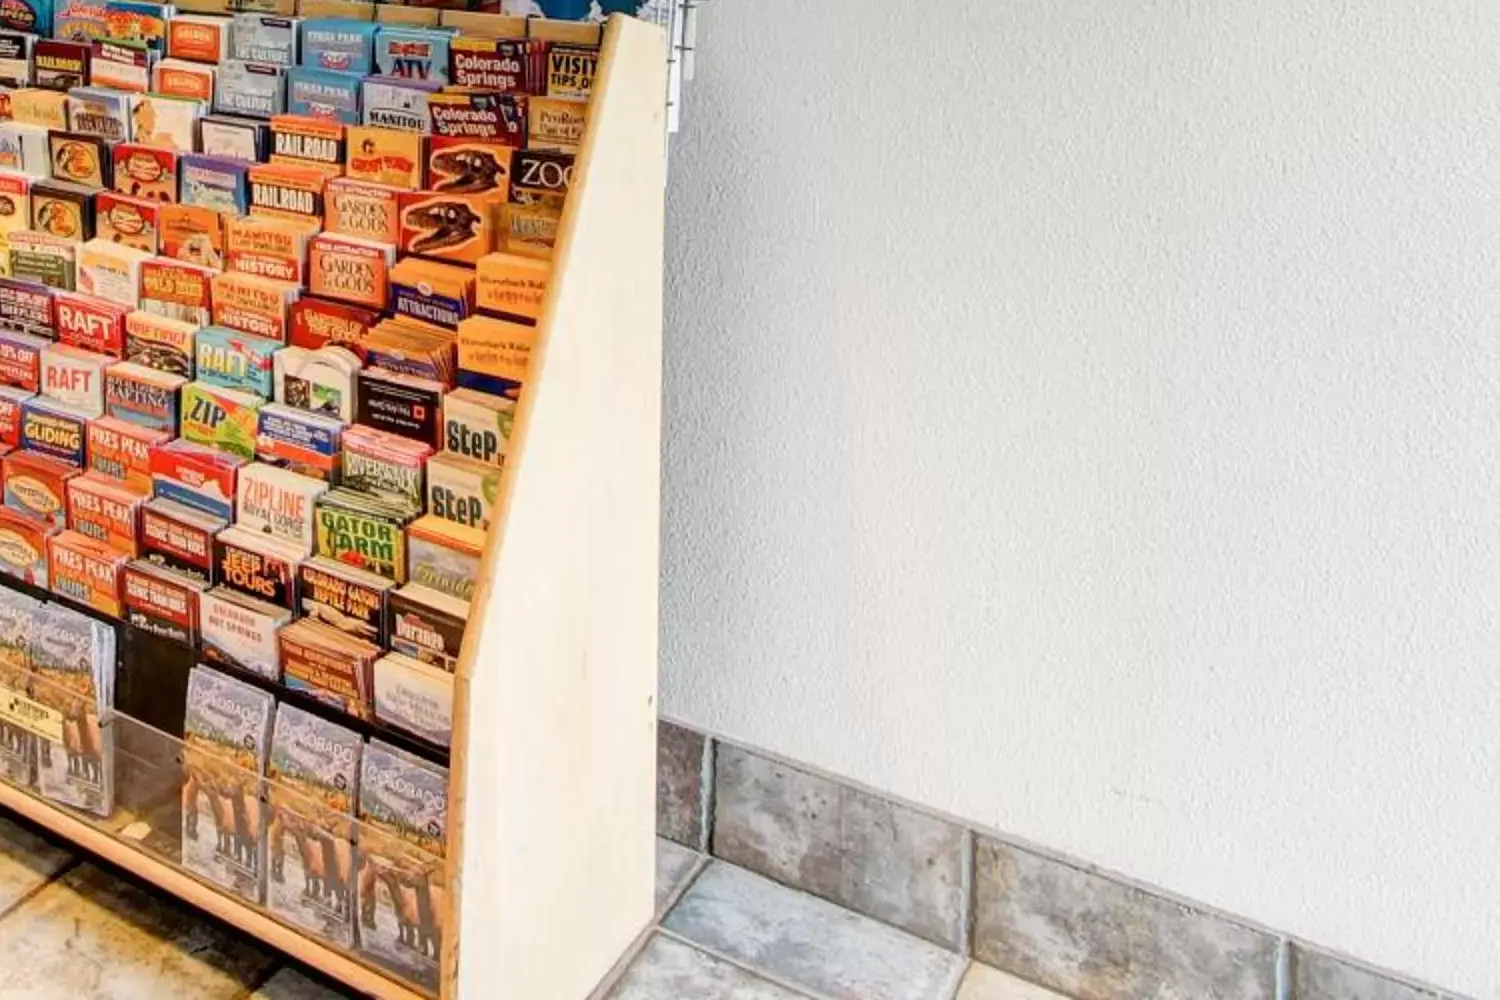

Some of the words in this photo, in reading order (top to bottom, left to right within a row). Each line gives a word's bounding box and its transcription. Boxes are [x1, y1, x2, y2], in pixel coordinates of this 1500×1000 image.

[391, 58, 432, 80] ATV
[455, 54, 520, 74] Colorado
[456, 70, 516, 89] Springs
[370, 112, 425, 130] MANITOU
[433, 106, 498, 123] Colorado
[439, 120, 497, 138] Springs
[276, 133, 338, 158] RAILROAD
[253, 184, 315, 213] RAILROAD
[232, 229, 292, 247] MANITOU
[350, 218, 389, 234] GODS
[316, 242, 333, 252] FREE
[334, 246, 380, 258] ATTRACTION
[236, 259, 294, 281] HISTORY
[320, 254, 376, 278] GARDEN
[335, 276, 376, 296] GODS
[398, 296, 460, 323] ATTRACTIONS
[59, 307, 111, 340] RAFT
[220, 313, 279, 337] HISTORY
[200, 343, 246, 376] RAFT
[47, 366, 91, 392] RAFT
[107, 385, 168, 409] RAFTING
[192, 397, 226, 428] ZIP
[25, 422, 81, 449] GLIDING
[121, 433, 150, 459] PEAK
[243, 476, 305, 518] ZIPLINE
[102, 499, 132, 524] PEAK
[321, 510, 394, 543] GATOR
[85, 560, 114, 586] PEAK
[222, 555, 262, 578] JEEP
[225, 566, 276, 598] TOURS
[303, 567, 347, 594] COLORADO
[313, 585, 346, 607] REPTILE
[347, 597, 370, 620] PARK
[227, 621, 263, 645] SPRINGS
